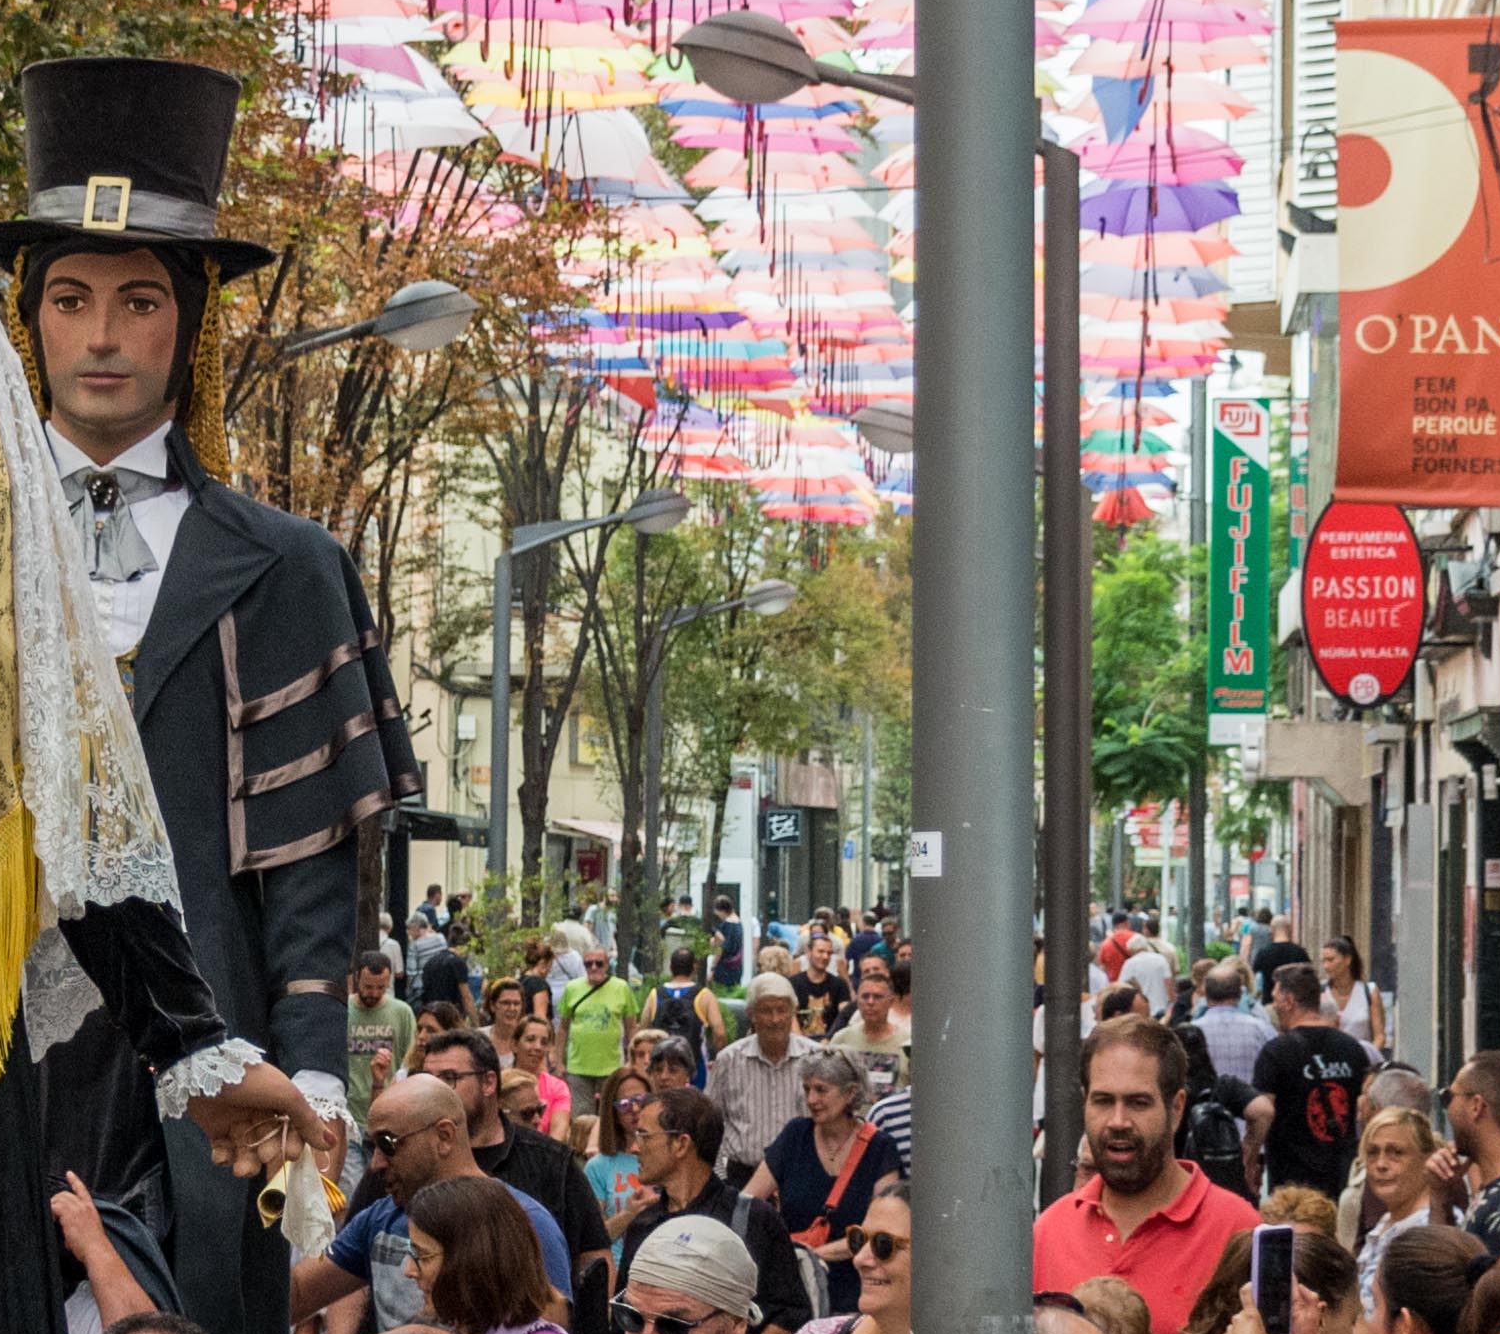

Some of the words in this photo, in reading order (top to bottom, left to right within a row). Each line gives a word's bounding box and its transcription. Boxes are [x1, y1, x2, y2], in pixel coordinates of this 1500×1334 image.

[1413, 376, 1457, 393] FEM
[1413, 397, 1457, 413] BON
[1412, 438, 1459, 454] SOM
[1223, 456, 1254, 676] FUJIFILM
[1311, 575, 1417, 600] PASSION
